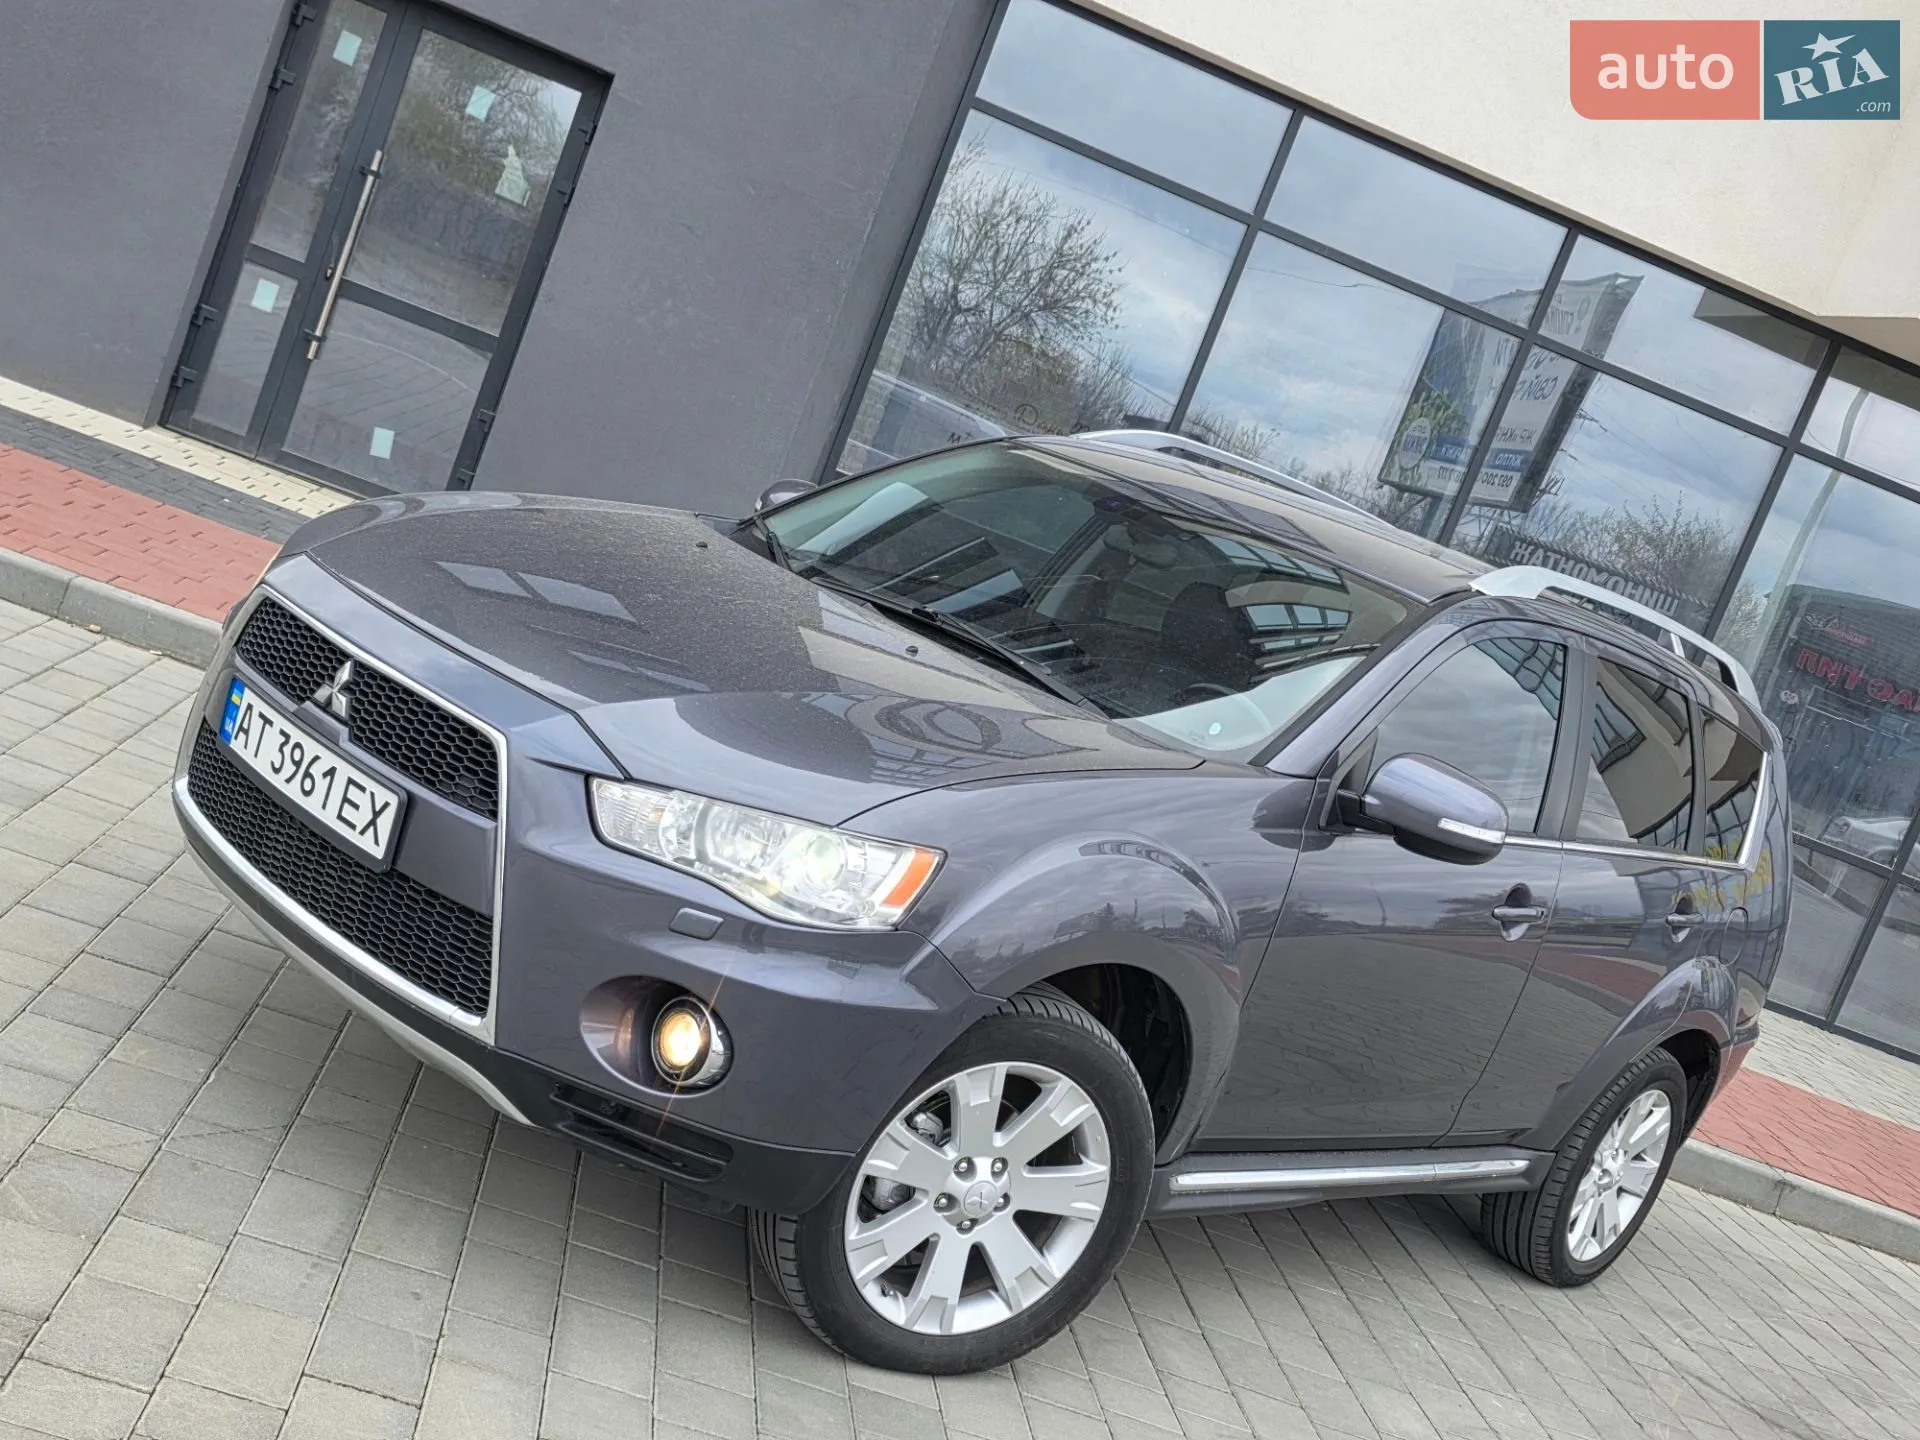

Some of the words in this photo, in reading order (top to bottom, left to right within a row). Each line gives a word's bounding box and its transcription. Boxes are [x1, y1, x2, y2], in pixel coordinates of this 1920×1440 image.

[234, 703, 273, 758] AT
[270, 729, 337, 811] 3961
[336, 776, 391, 847] EX
